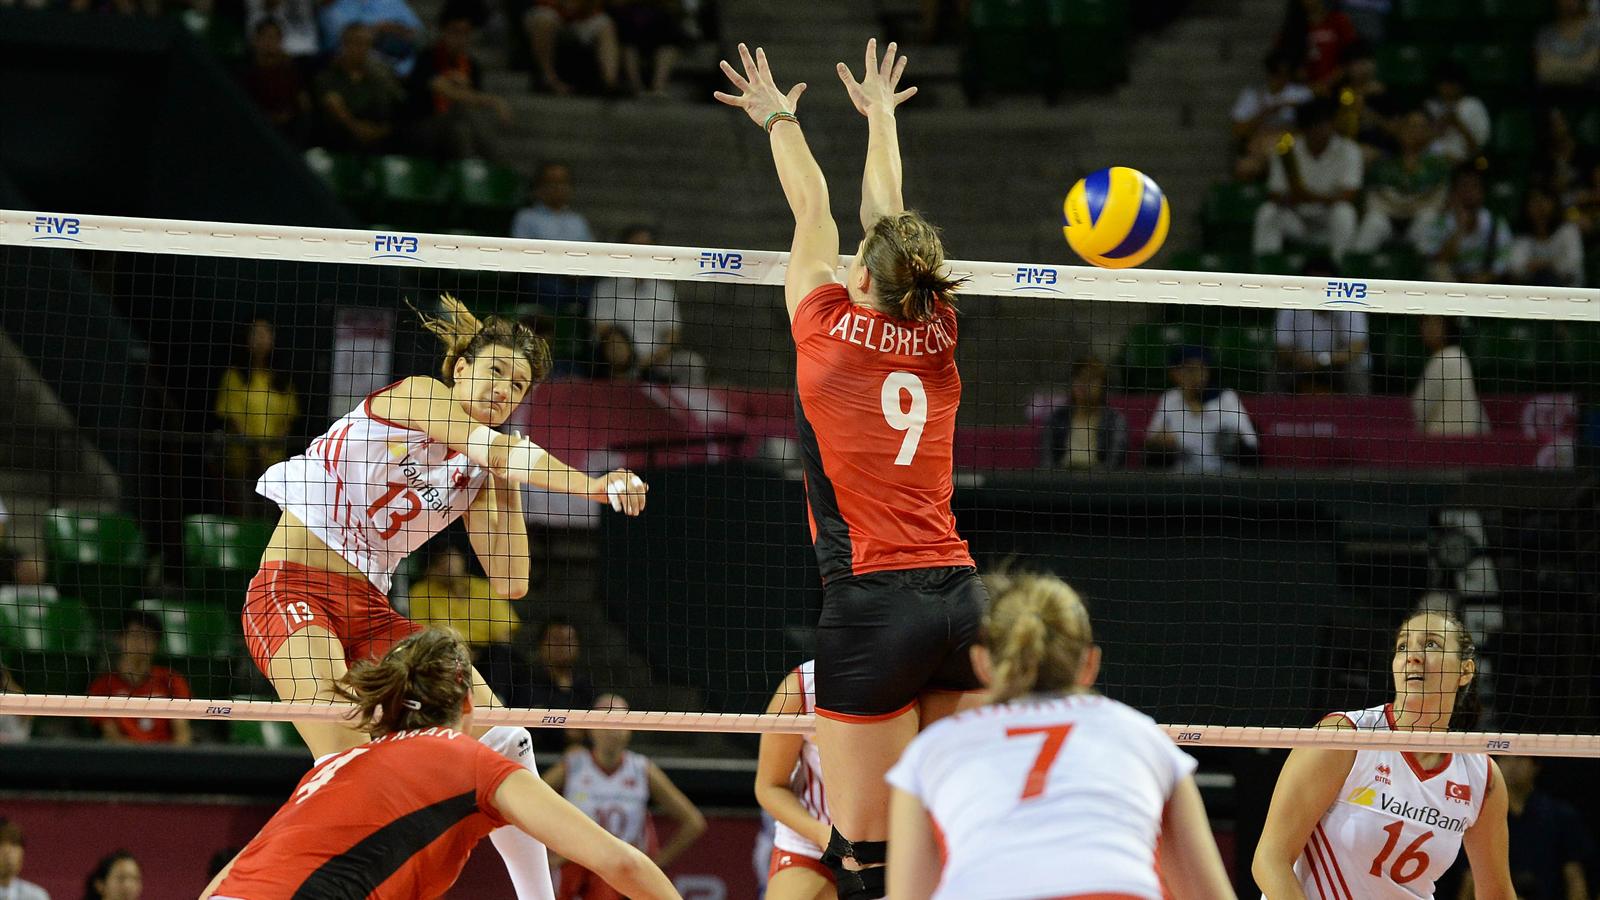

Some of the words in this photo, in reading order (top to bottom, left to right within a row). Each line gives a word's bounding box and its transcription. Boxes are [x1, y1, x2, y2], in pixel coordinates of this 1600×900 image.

[34, 216, 80, 235] FIVB
[374, 235, 419, 253] FIVB
[700, 252, 743, 270] FIVB
[1016, 267, 1058, 285] FIVB
[1326, 281, 1368, 299] FIVB
[880, 370, 928, 466] 9
[366, 481, 423, 541] 13
[286, 601, 315, 624] 13
[205, 706, 232, 715] FIVB
[541, 716, 567, 724] FIVB
[1177, 732, 1202, 741] FIVB
[1487, 740, 1511, 749] FIVB
[1005, 721, 1074, 800] 7
[1368, 820, 1434, 885] 16
